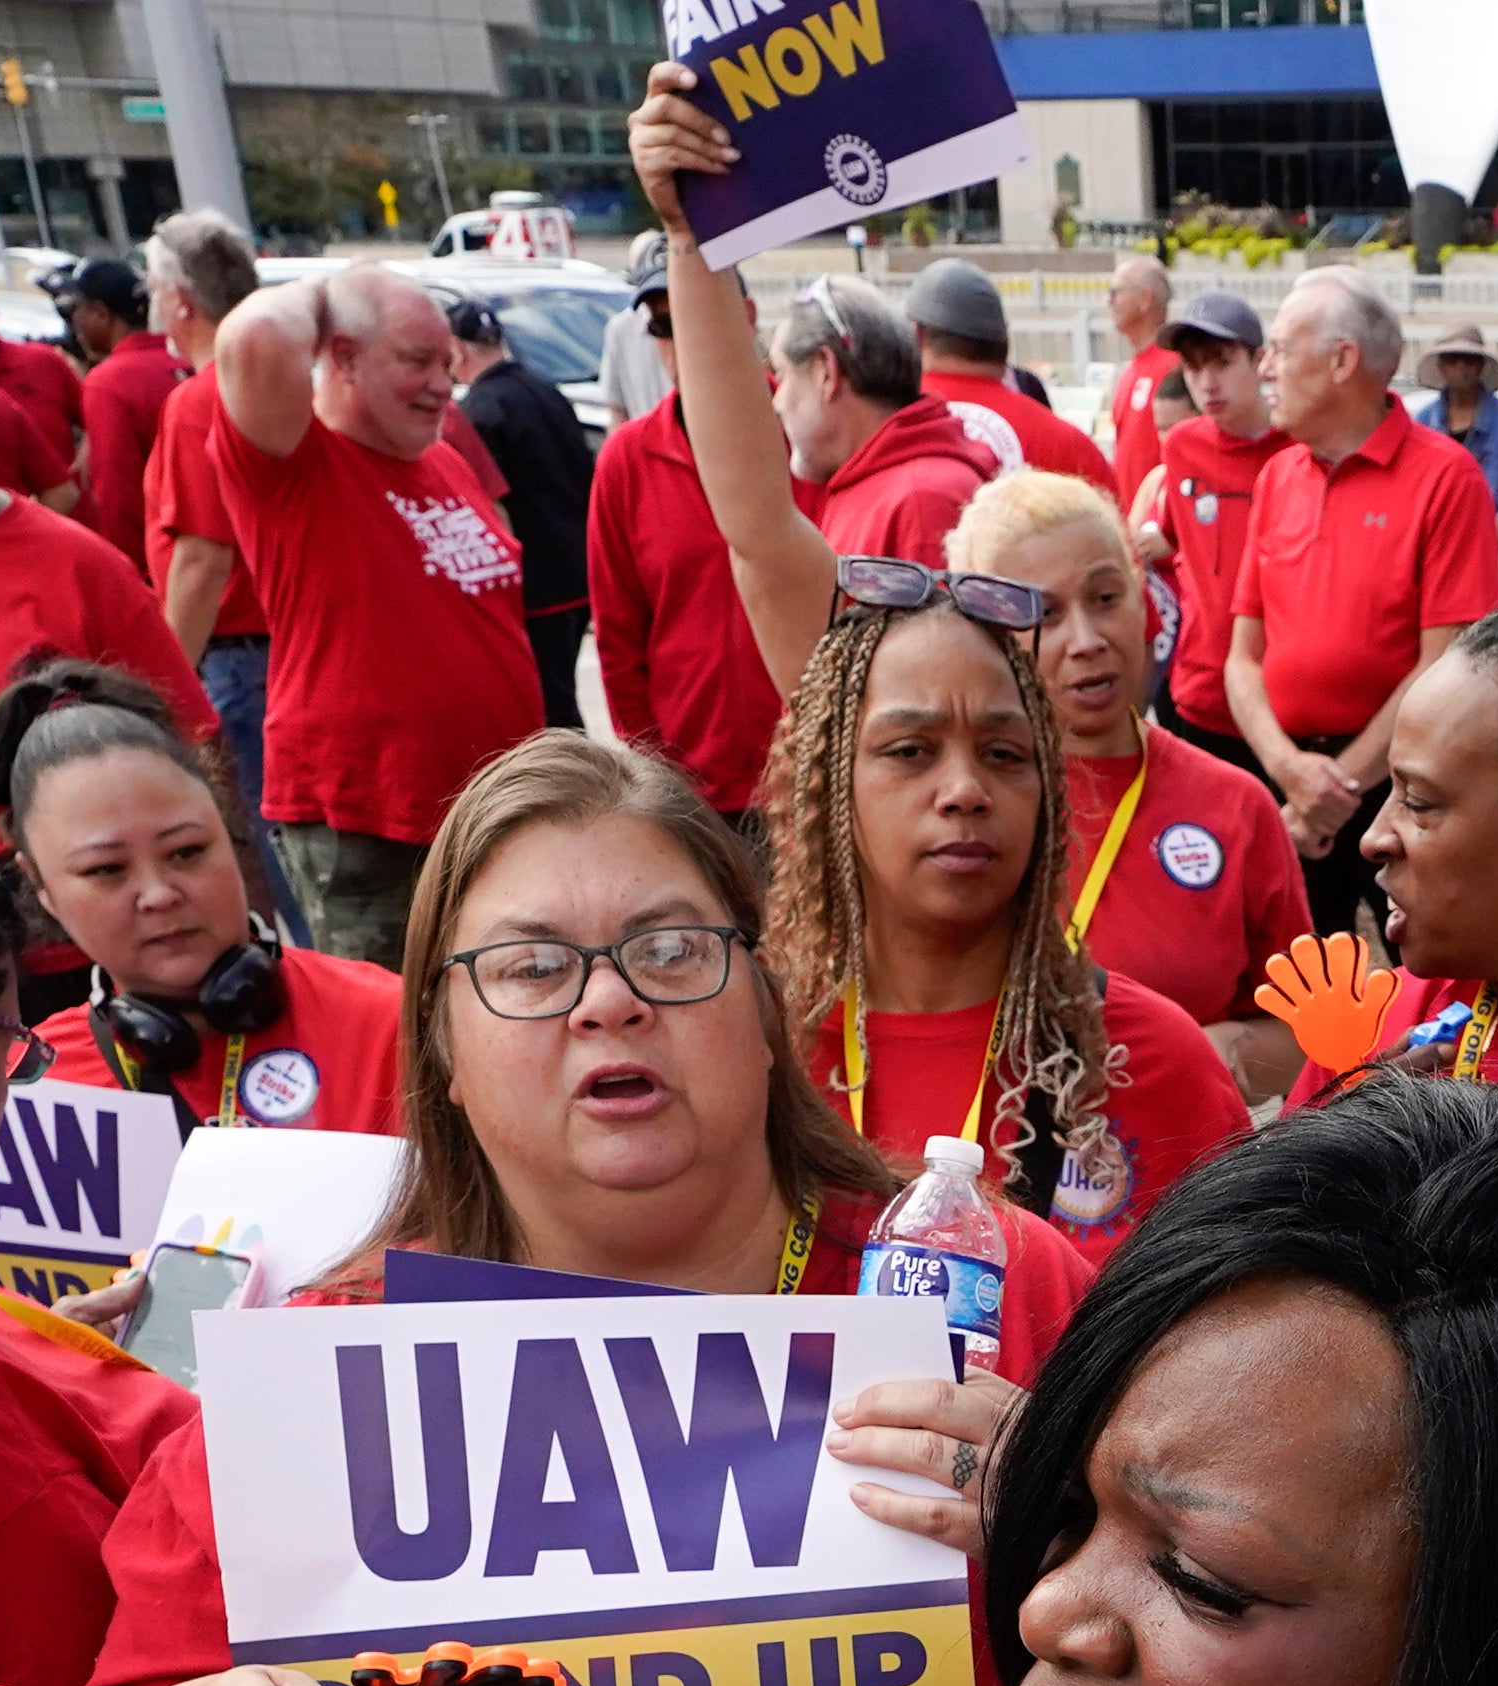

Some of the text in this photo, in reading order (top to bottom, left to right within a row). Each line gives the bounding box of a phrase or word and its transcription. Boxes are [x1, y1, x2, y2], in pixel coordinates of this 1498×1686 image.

[709, 0, 886, 122] NOW
[890, 1250, 942, 1277] Pure
[892, 1272, 932, 1297] Life
[336, 1332, 835, 1581] UAW
